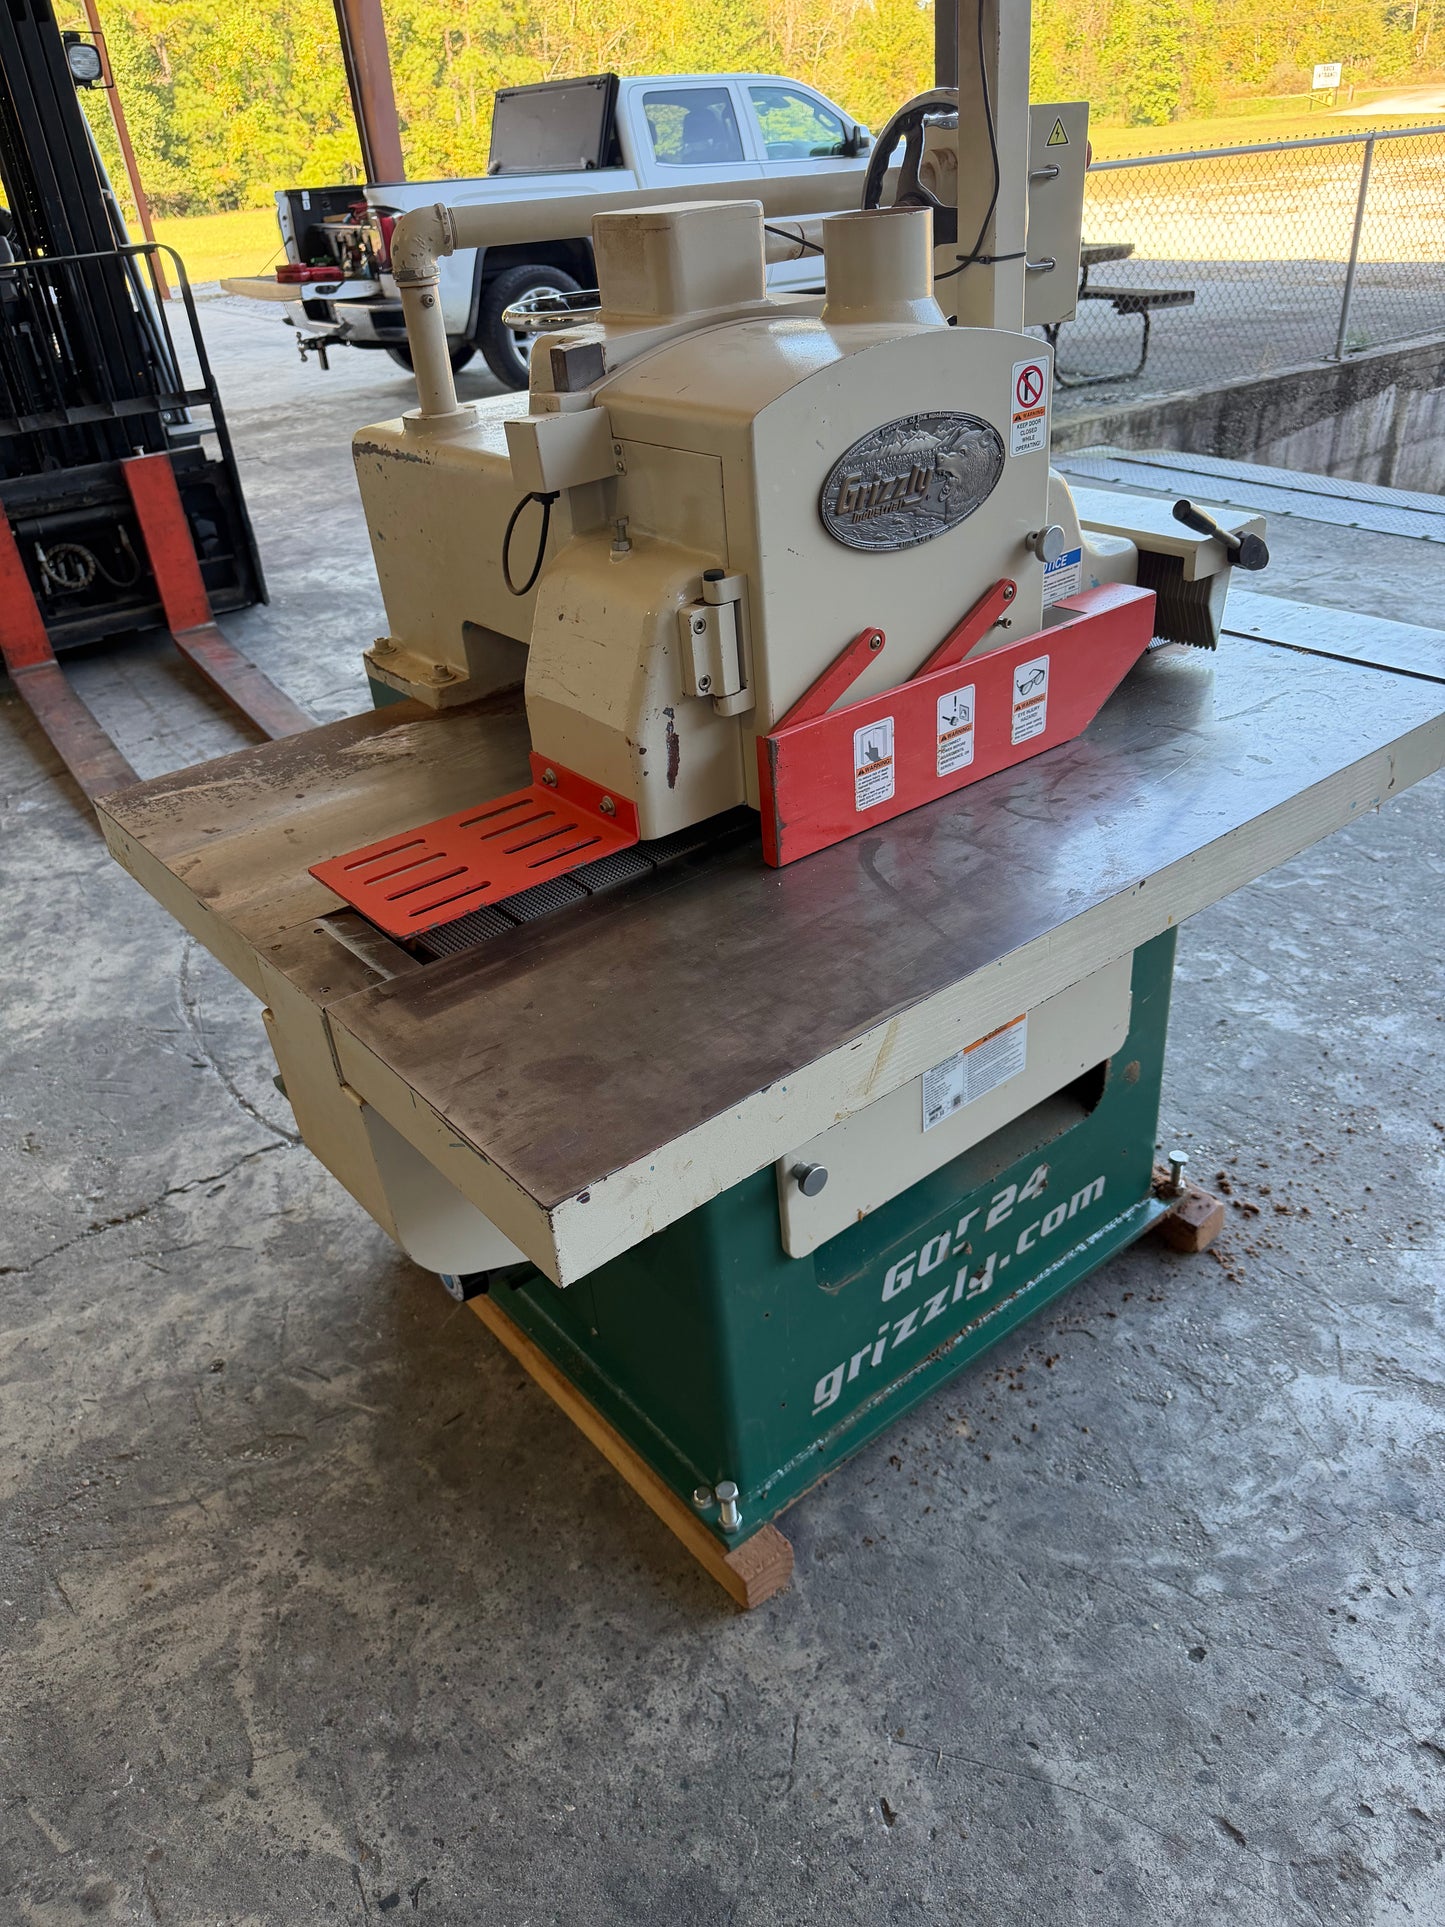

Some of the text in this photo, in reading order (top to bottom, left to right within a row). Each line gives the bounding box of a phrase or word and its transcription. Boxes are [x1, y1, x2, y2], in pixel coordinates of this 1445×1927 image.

[1028, 419, 1041, 427] DOOR
[1020, 427, 1038, 436] CLOSED
[835, 462, 934, 516] Grizzly
[1026, 706, 1040, 715] INJURY
[864, 759, 892, 773] WARNING!
[812, 1175, 1106, 1416] grizzly.com
